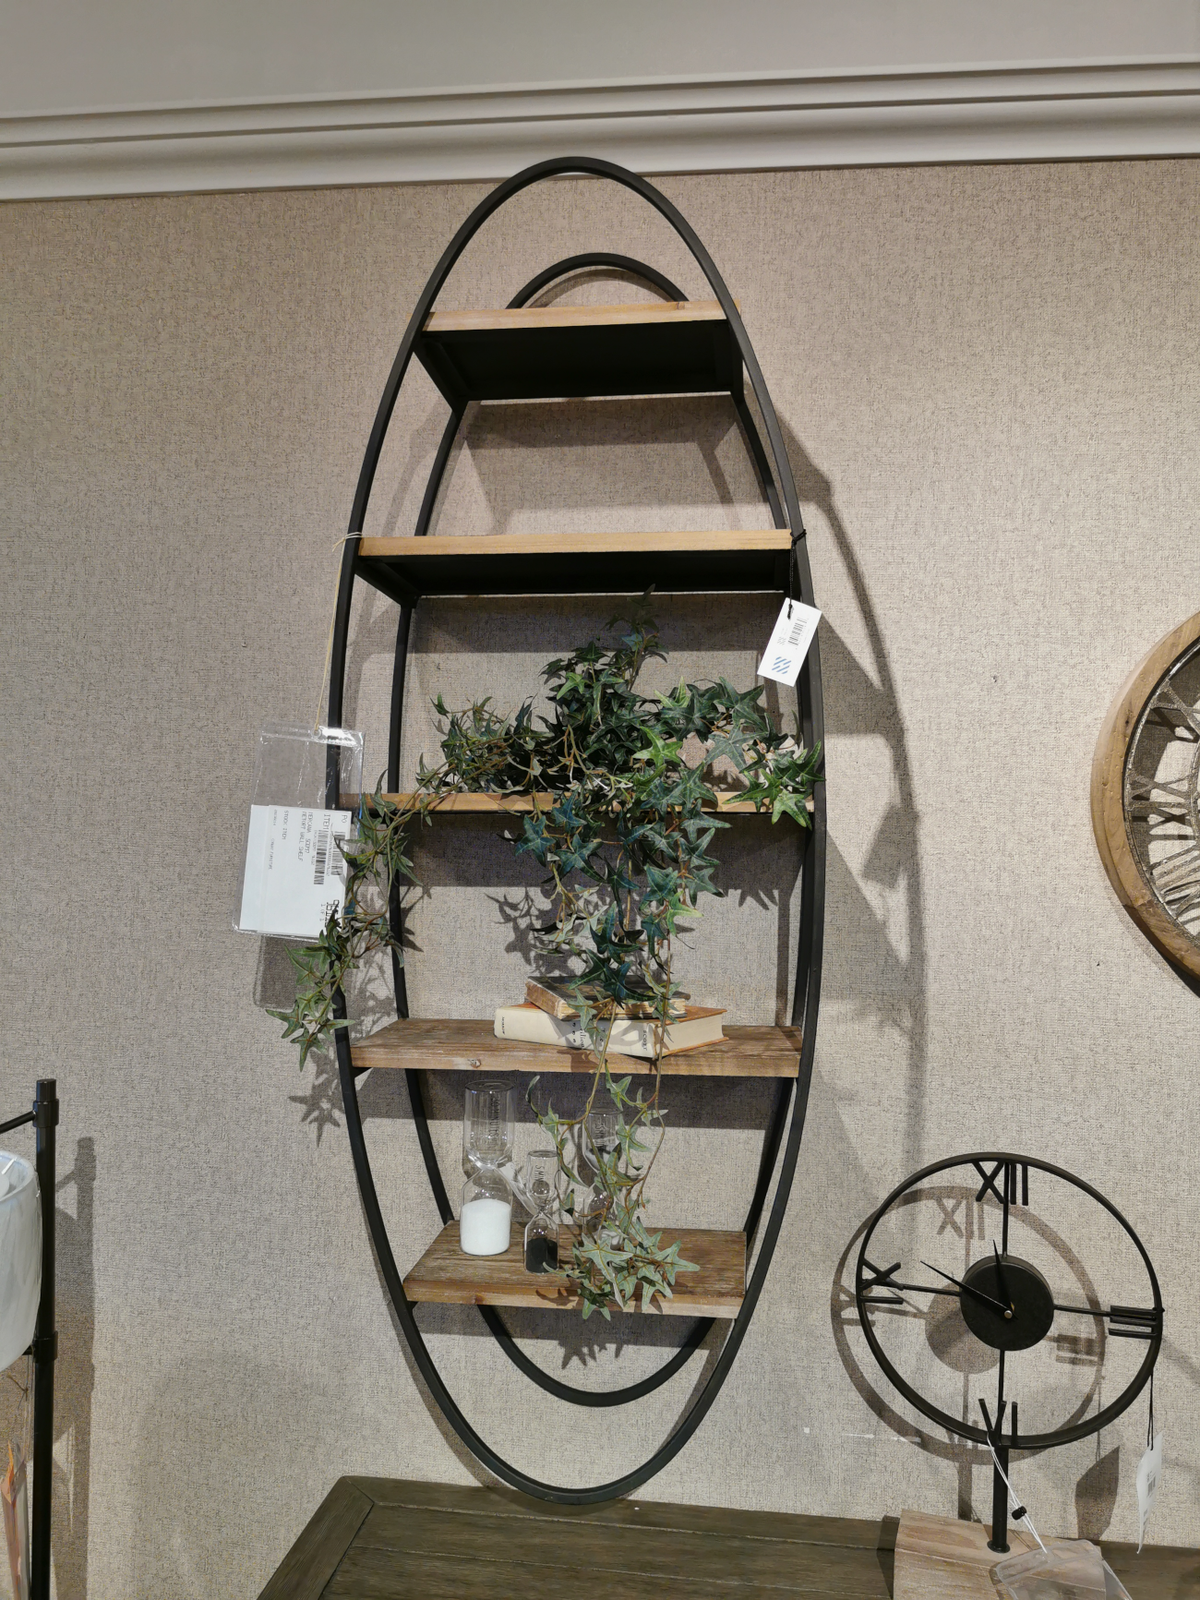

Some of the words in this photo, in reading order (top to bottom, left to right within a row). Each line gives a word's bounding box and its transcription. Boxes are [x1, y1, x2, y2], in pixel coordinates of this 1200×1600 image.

[322, 813, 331, 830] ITEM
[972, 1161, 1030, 1207] XII
[857, 1256, 905, 1306] IX
[1107, 1304, 1158, 1340] III
